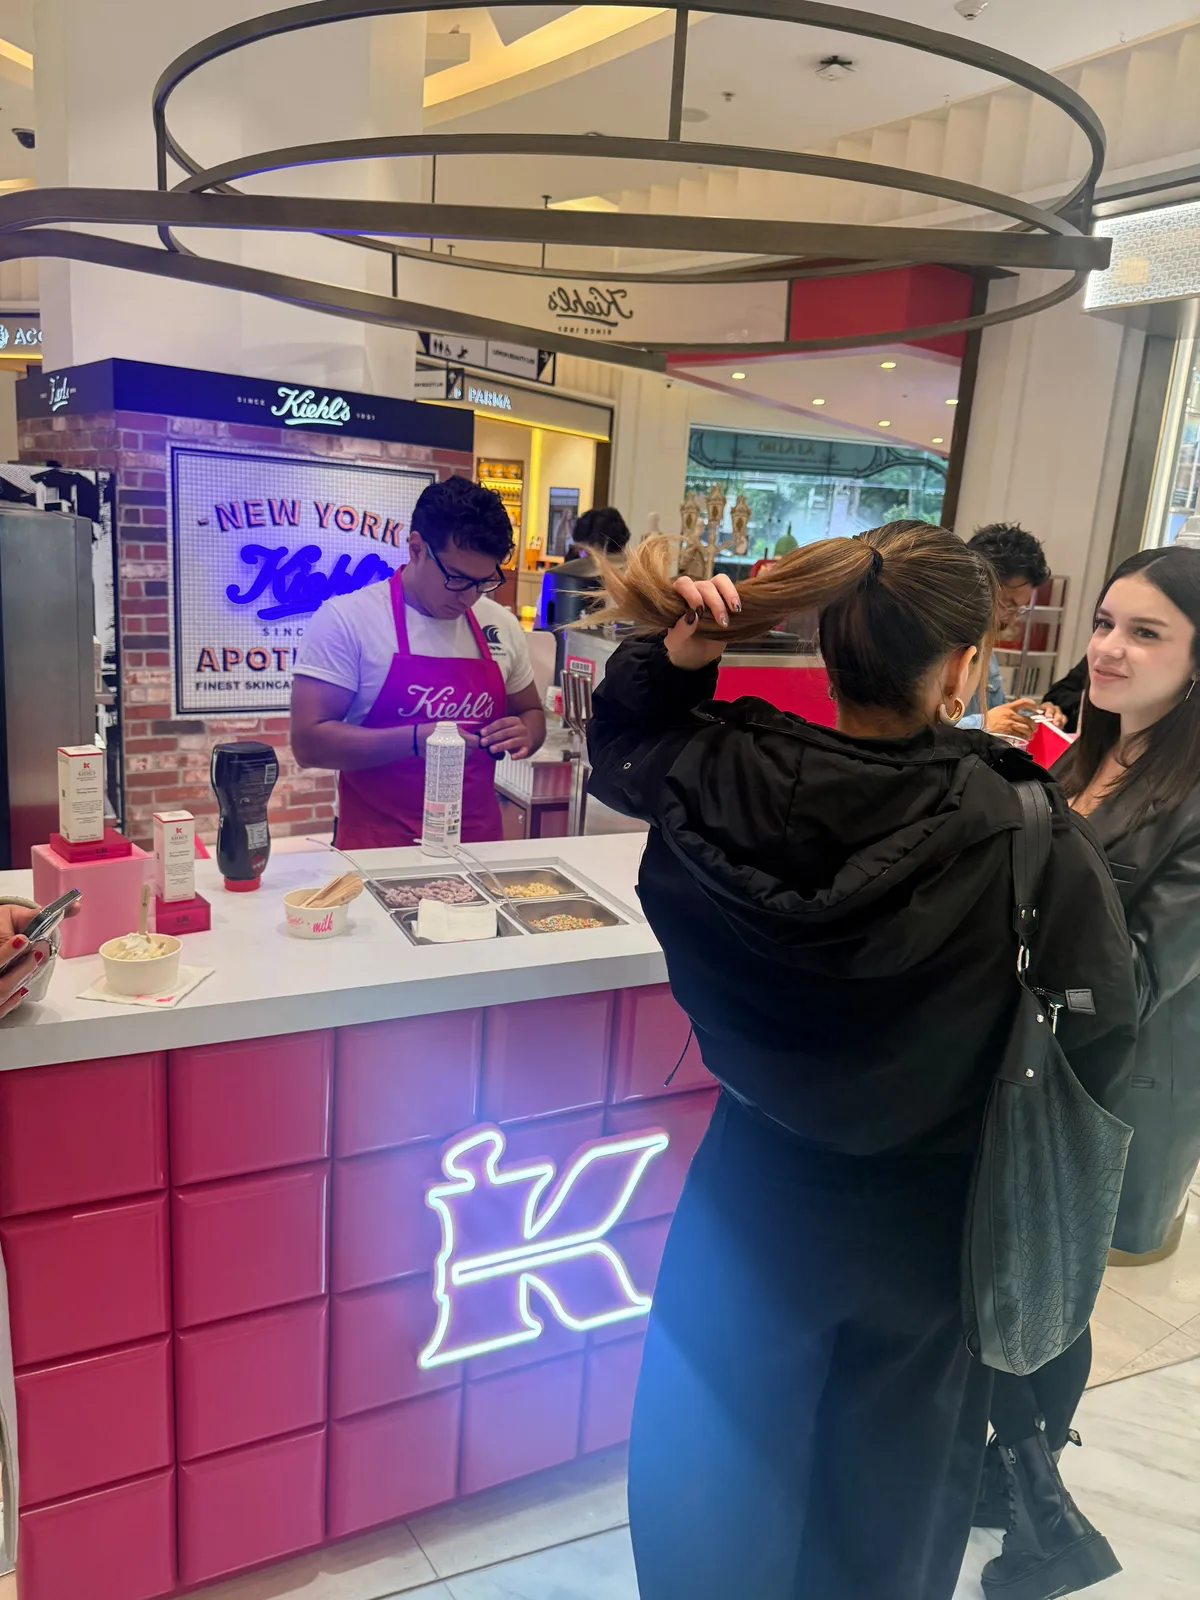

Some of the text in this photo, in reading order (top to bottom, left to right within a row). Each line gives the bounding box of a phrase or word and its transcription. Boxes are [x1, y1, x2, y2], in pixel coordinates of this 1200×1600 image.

[237, 396, 265, 406] SINCE
[271, 387, 351, 423] Kiehl's
[468, 386, 511, 410] PARMA
[215, 498, 404, 548] NEW YORK
[262, 627, 304, 637] SINC
[195, 680, 294, 691] FINEST SKINCA
[398, 684, 495, 719] Kiehl's
[312, 911, 334, 933] milk
